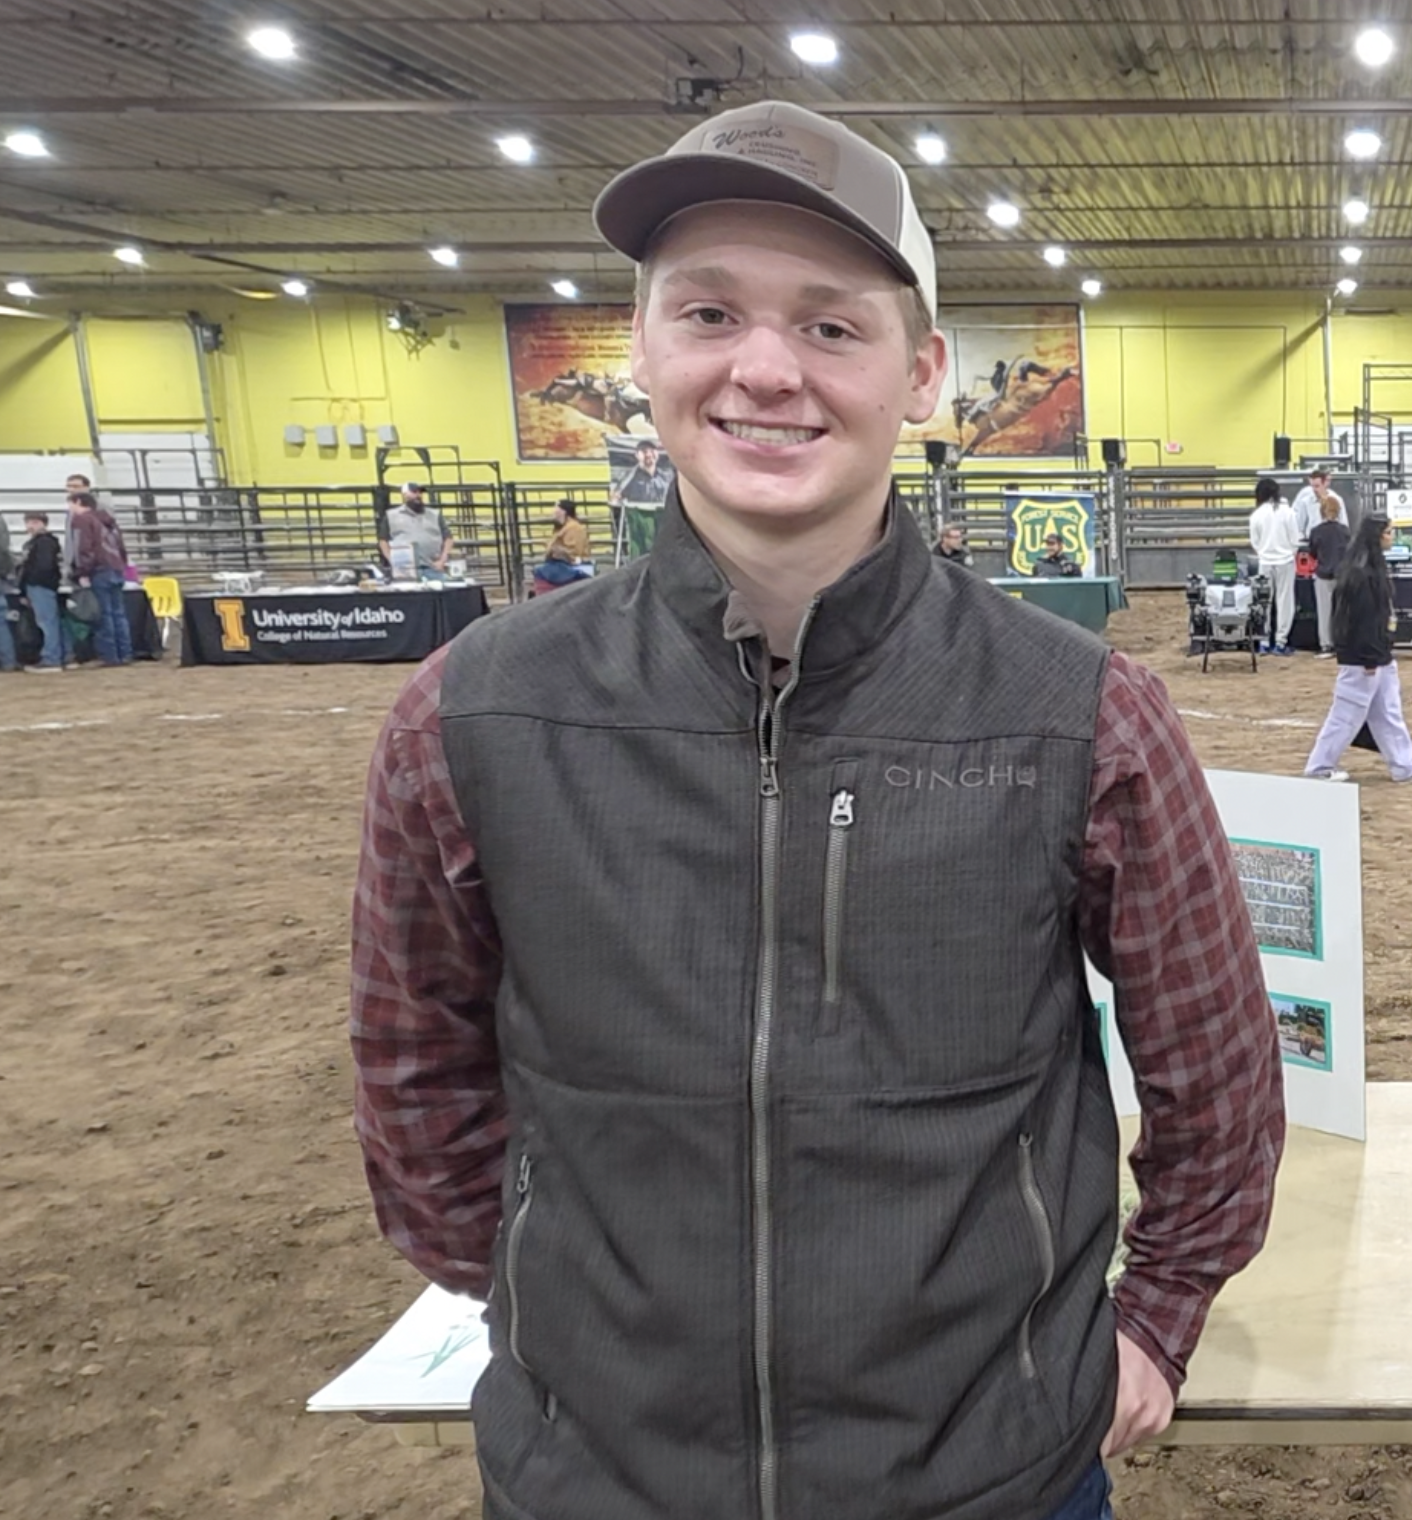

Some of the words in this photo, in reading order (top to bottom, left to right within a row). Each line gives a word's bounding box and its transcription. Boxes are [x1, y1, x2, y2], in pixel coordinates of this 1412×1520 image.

[712, 126, 783, 149] Wood's
[252, 608, 340, 630] University
[341, 613, 355, 627] of
[354, 606, 405, 624] Idaho
[257, 630, 291, 643] College
[292, 630, 303, 641] of
[304, 629, 340, 641] Natural
[341, 629, 388, 640] Resources
[884, 764, 1013, 791] CINCH
